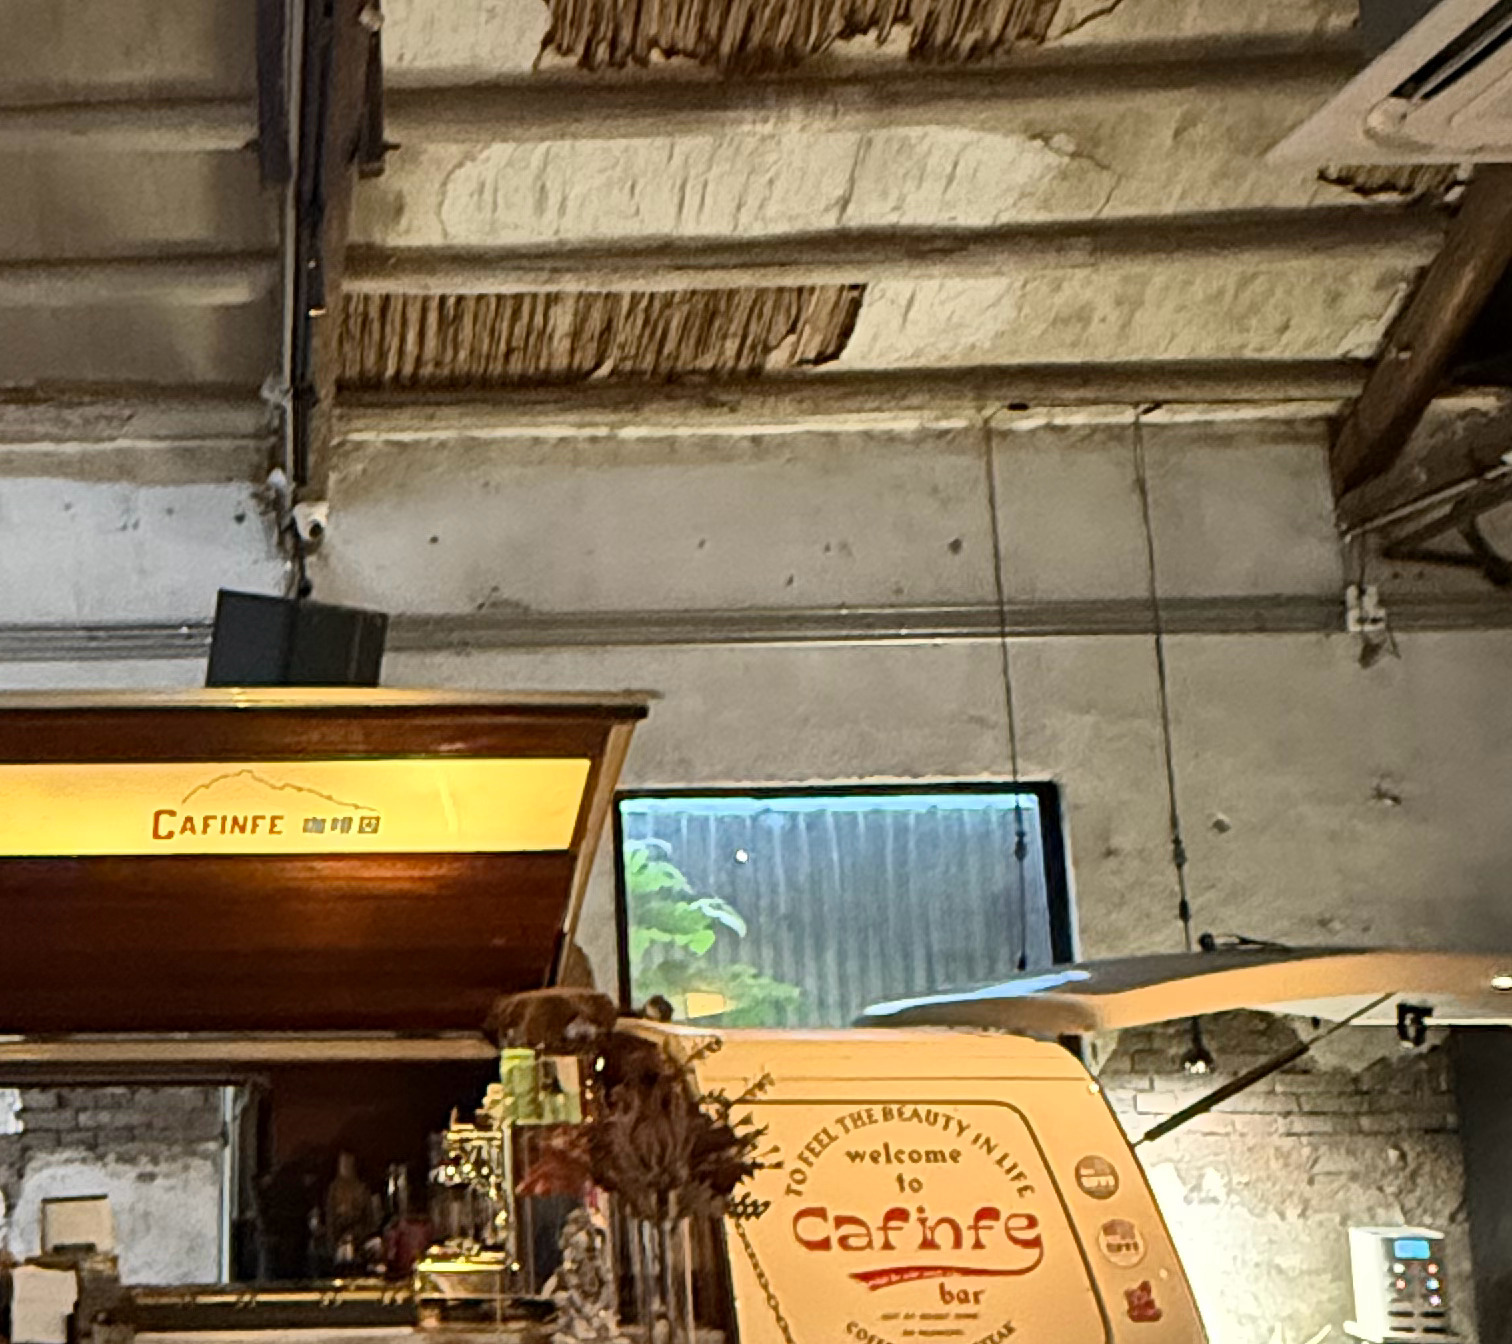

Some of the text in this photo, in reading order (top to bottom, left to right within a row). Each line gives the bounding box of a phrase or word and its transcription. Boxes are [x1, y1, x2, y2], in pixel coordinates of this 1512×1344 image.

[152, 809, 285, 840] CAFINFE
[785, 1105, 1036, 1198] TO FEEL THE BEAUTY IN LIFE
[844, 1142, 962, 1165] welcome
[896, 1172, 924, 1194] to
[939, 1281, 986, 1306] bar
